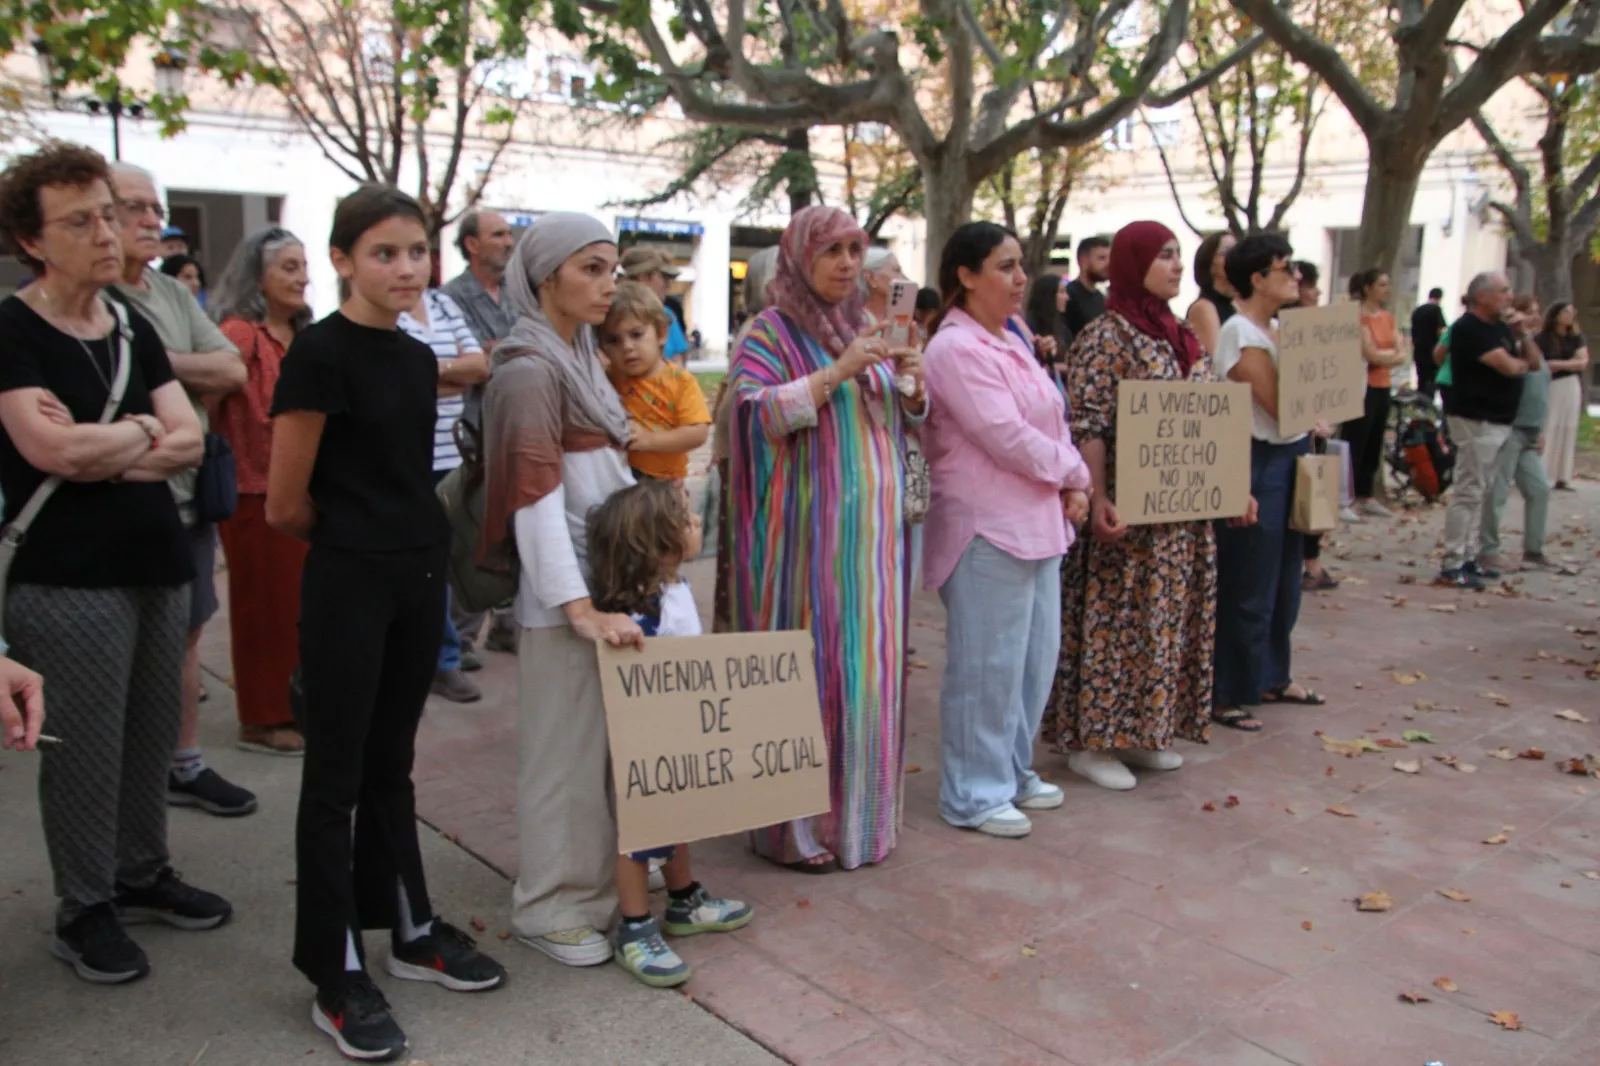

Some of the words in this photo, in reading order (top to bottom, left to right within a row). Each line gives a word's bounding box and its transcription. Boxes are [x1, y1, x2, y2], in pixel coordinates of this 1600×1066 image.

[1298, 358, 1317, 383] NO
[1322, 355, 1339, 381] ES
[1130, 391, 1148, 415] LA
[1158, 391, 1230, 417] VIVIENDA
[1156, 418, 1175, 438] ES
[1183, 418, 1202, 438] UN
[1139, 440, 1217, 469] DERECHO
[1159, 468, 1180, 487] NO
[1187, 469, 1206, 487] UN
[1143, 485, 1222, 516] NEGOCIO
[616, 659, 717, 697] VIVIENDA
[725, 650, 801, 690] PUBLICA
[700, 697, 732, 734] DE
[626, 748, 734, 799] ALQUILER
[752, 736, 823, 779] SOCIAL
